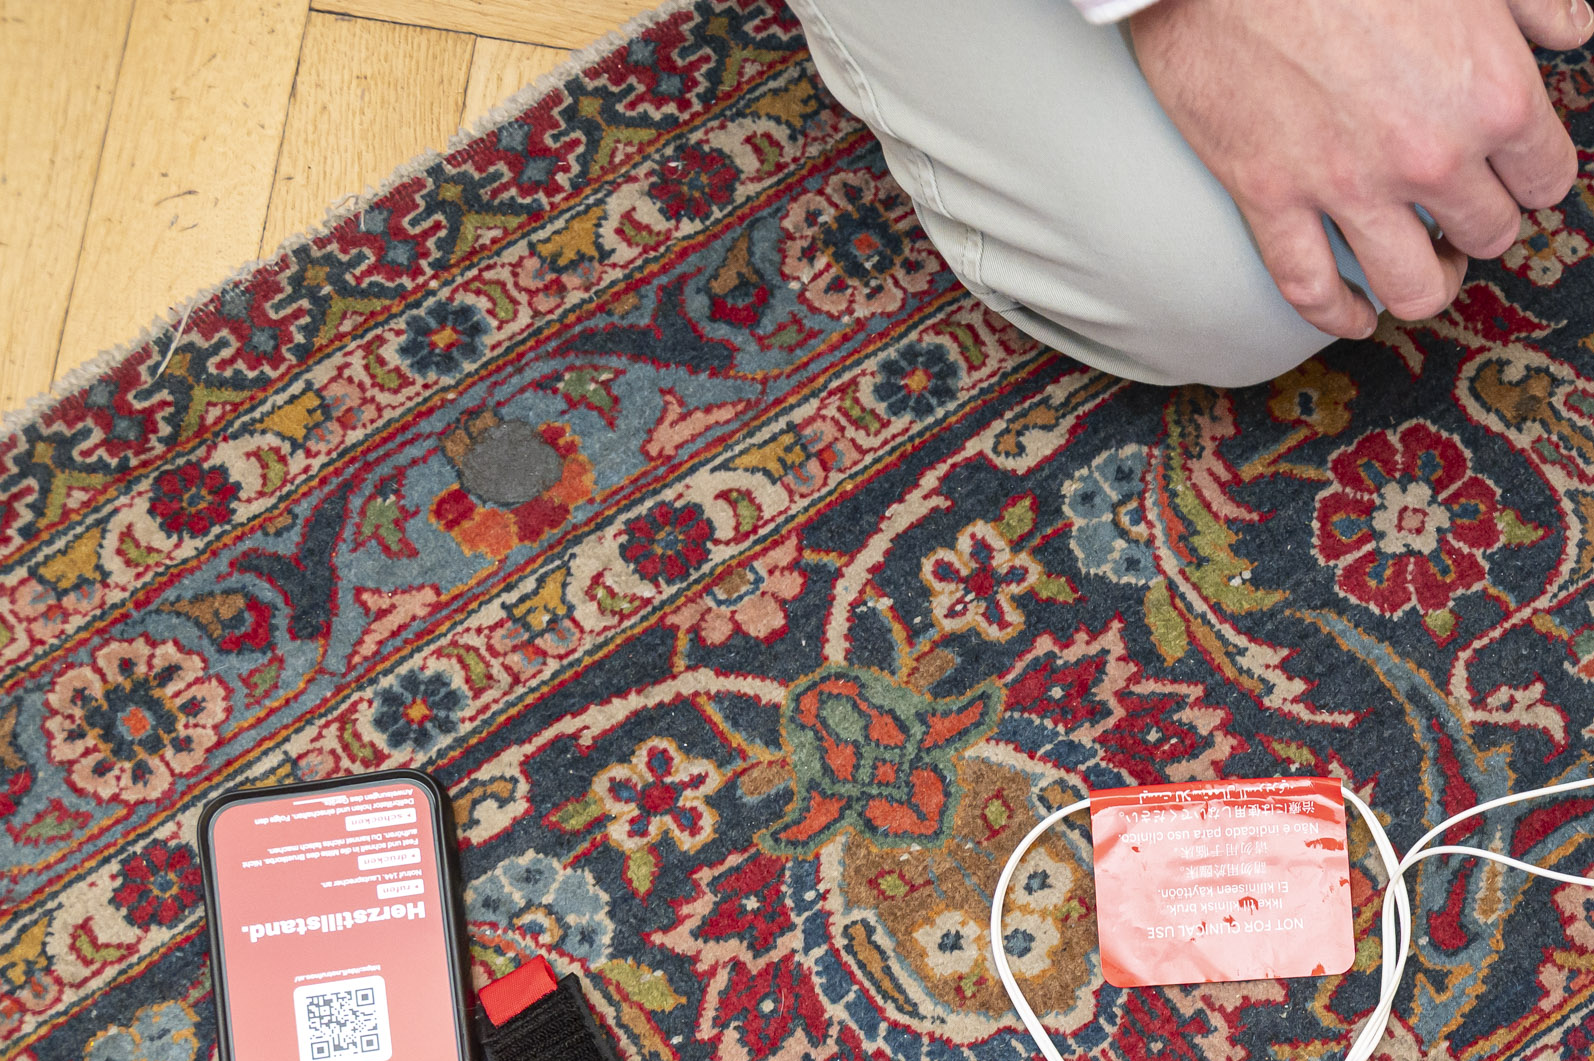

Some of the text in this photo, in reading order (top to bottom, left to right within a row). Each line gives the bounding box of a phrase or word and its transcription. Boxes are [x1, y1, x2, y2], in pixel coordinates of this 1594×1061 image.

[335, 806, 351, 815] und
[1166, 829, 1189, 840] uso
[1192, 826, 1221, 839] para
[1224, 823, 1279, 839] indicado
[1293, 821, 1319, 835] Não
[370, 833, 383, 841] Du
[387, 840, 402, 849] und
[398, 868, 423, 879] Notruf
[333, 874, 382, 887] Lautsprecher
[1277, 881, 1288, 892] Ei
[1157, 883, 1212, 900] käyttöön.
[1166, 902, 1196, 916] bruk.
[1200, 899, 1239, 914] klinisk
[1258, 897, 1282, 910] Ikke
[241, 900, 426, 943] Herzstillstand.
[1146, 917, 1303, 939] NOT FOR CLINICAL USE
